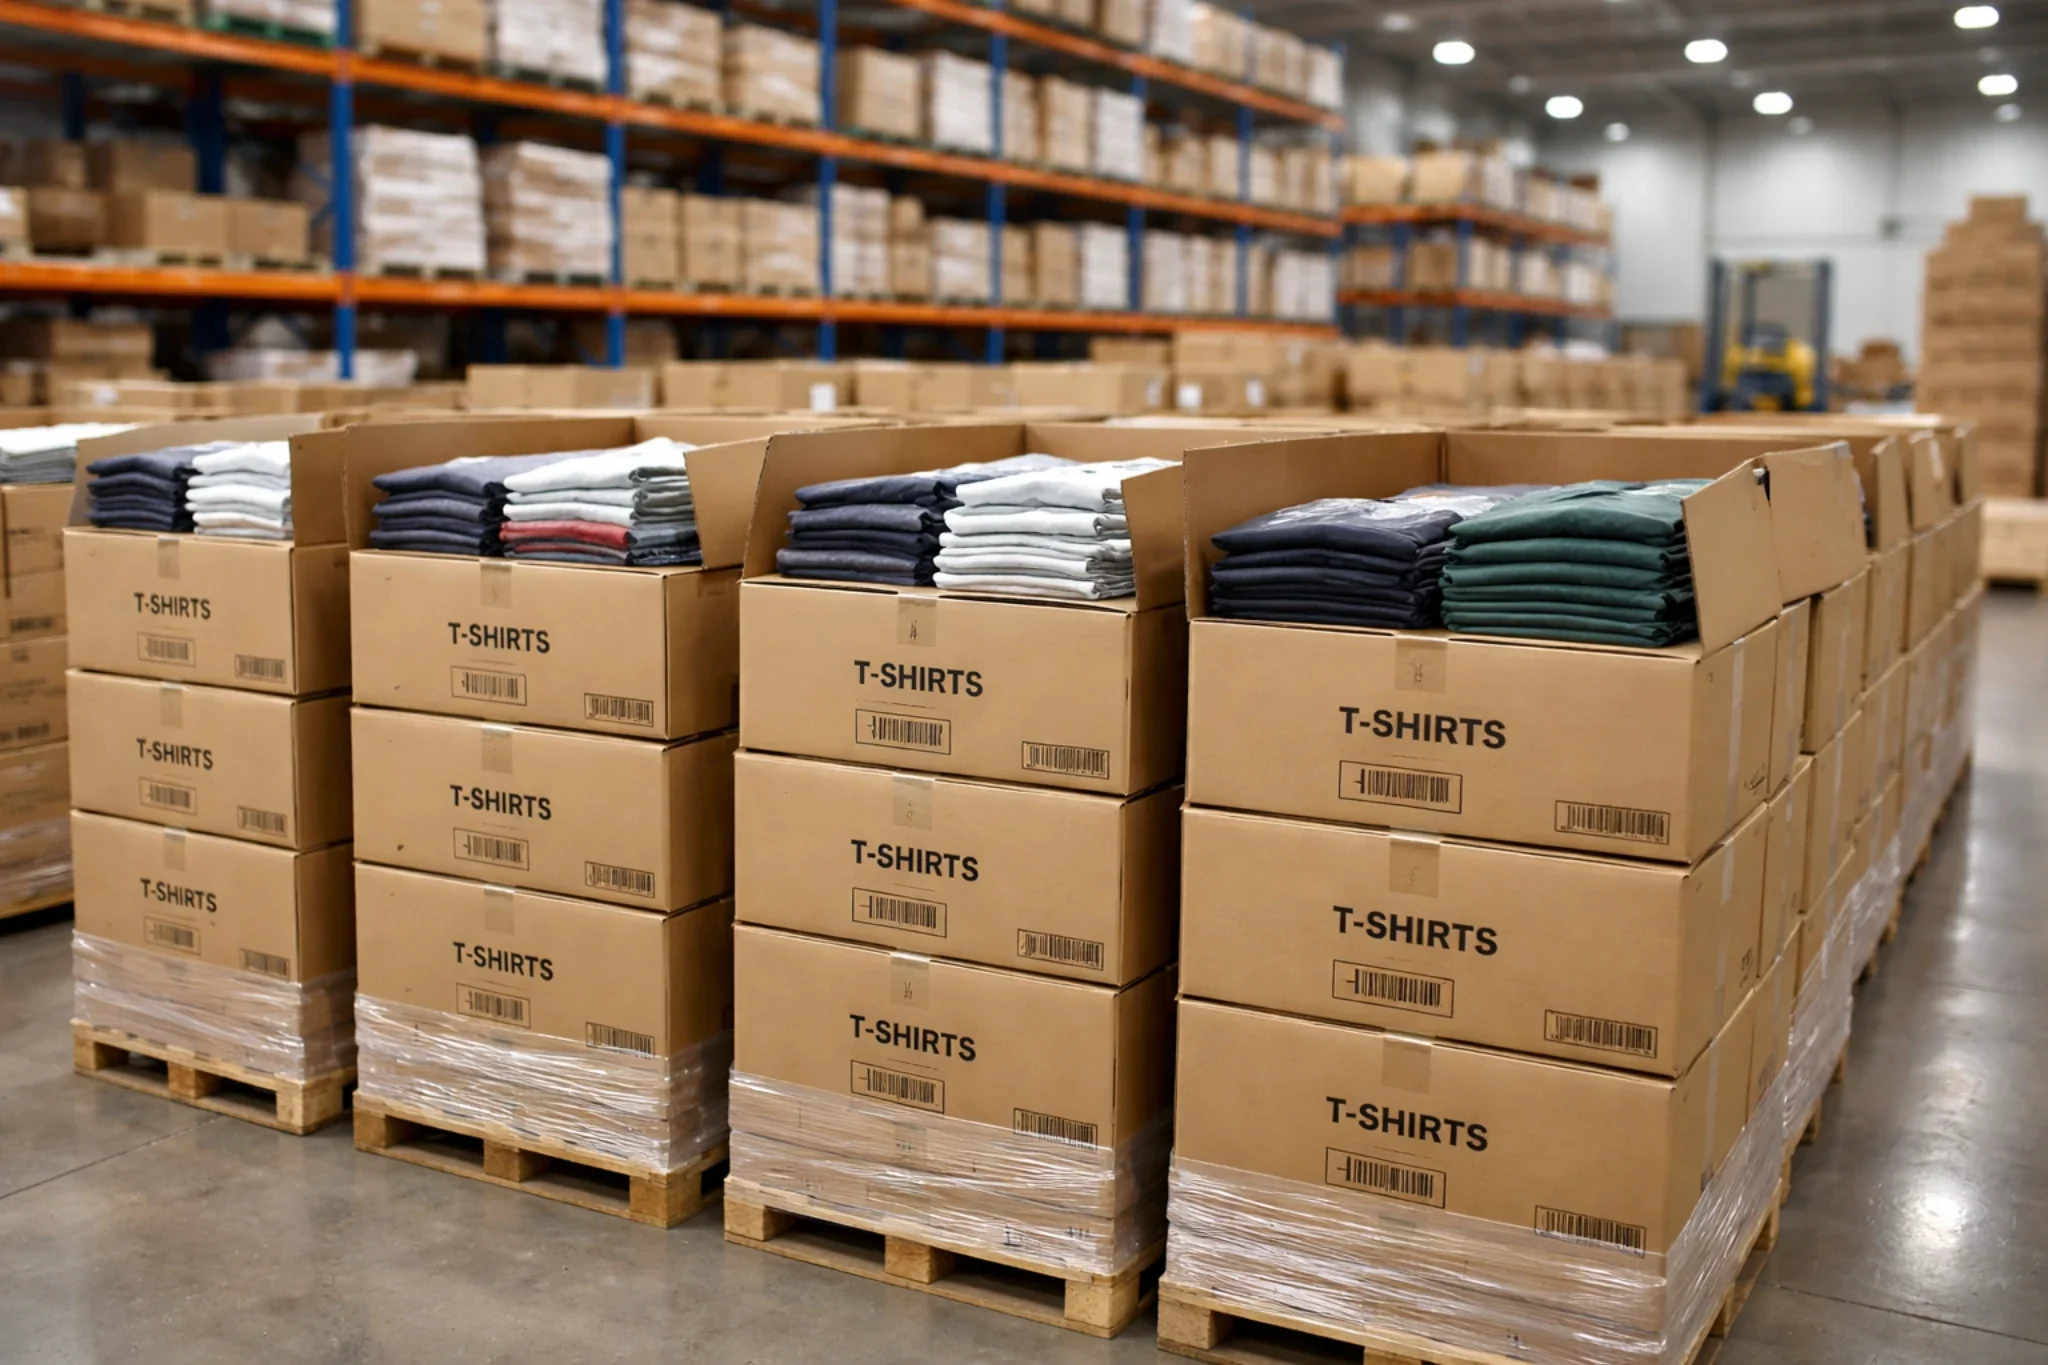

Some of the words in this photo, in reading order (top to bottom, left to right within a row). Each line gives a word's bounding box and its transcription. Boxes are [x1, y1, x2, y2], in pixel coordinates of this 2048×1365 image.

[133, 592, 211, 621] T-SHIRTS
[447, 622, 551, 654] T-SHIRTS
[854, 659, 984, 698] T-SHIRTS
[1339, 706, 1506, 750] T-SHIRTS
[136, 737, 214, 771] T-SHIRTS
[449, 784, 552, 821] T-SHIRTS
[850, 839, 979, 882] T-SHIRTS
[139, 877, 218, 913] T-SHIRTS
[1332, 905, 1498, 957] T-SHIRTS
[452, 941, 554, 982] T-SHIRTS
[849, 1013, 977, 1062] T-SHIRTS
[1326, 1095, 1488, 1152] T-SHIRTS
